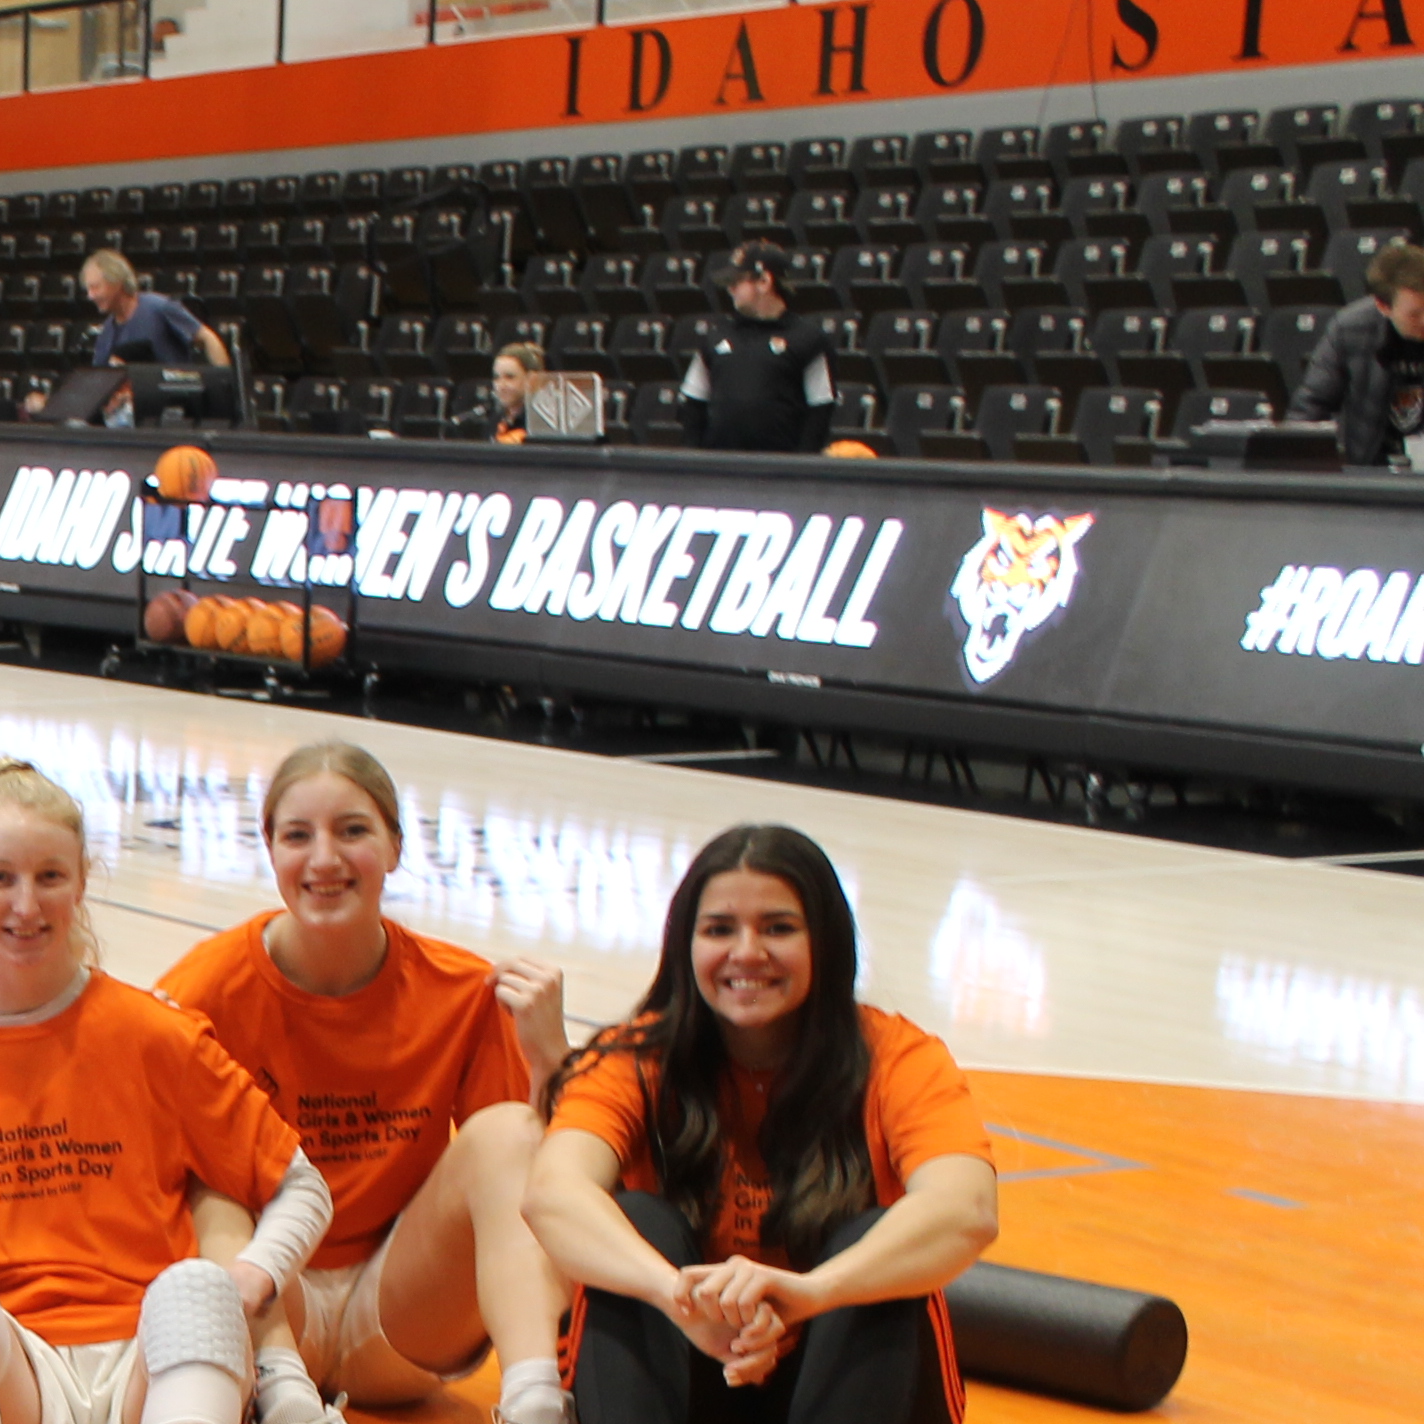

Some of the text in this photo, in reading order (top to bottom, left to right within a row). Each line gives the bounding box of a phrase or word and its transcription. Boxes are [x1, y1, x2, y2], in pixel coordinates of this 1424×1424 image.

[559, 0, 985, 118] IDAHO
[112, 474, 270, 577] SATE
[490, 497, 904, 648] BASKETBALL
[1239, 564, 1424, 665] #ROA
[298, 1090, 377, 1109] National
[297, 1105, 432, 1128] Girls & Women
[40, 1143, 52, 1159] &
[56, 1138, 123, 1155] Women
[319, 1130, 380, 1149] Sports
[386, 1125, 421, 1142] Day
[17, 1162, 73, 1185] Sports
[78, 1158, 113, 1180] Day
